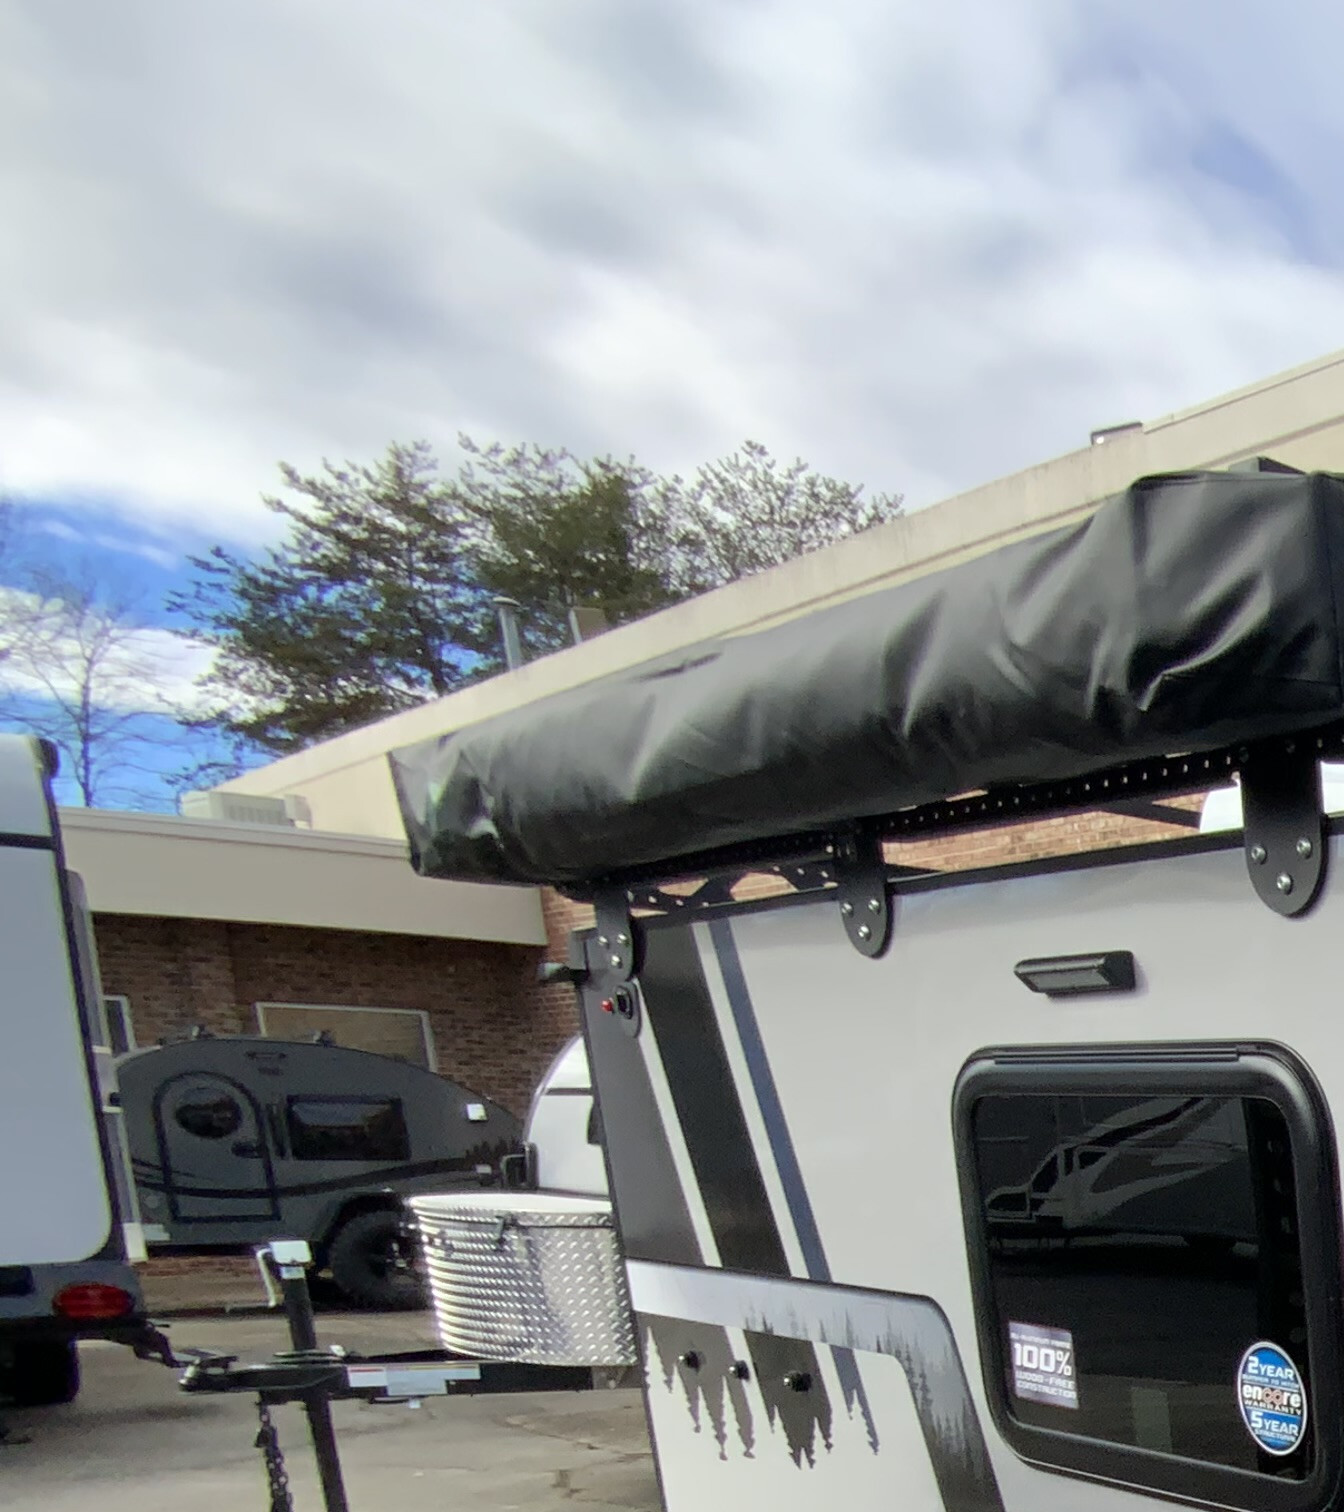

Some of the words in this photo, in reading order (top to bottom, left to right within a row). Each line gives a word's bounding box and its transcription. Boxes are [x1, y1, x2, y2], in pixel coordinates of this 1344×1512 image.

[1013, 1342, 1073, 1377] 100%
[1259, 1364, 1295, 1382] YEAR
[1244, 1399, 1302, 1416] WARRANTY
[1263, 1420, 1299, 1437] YEAR
